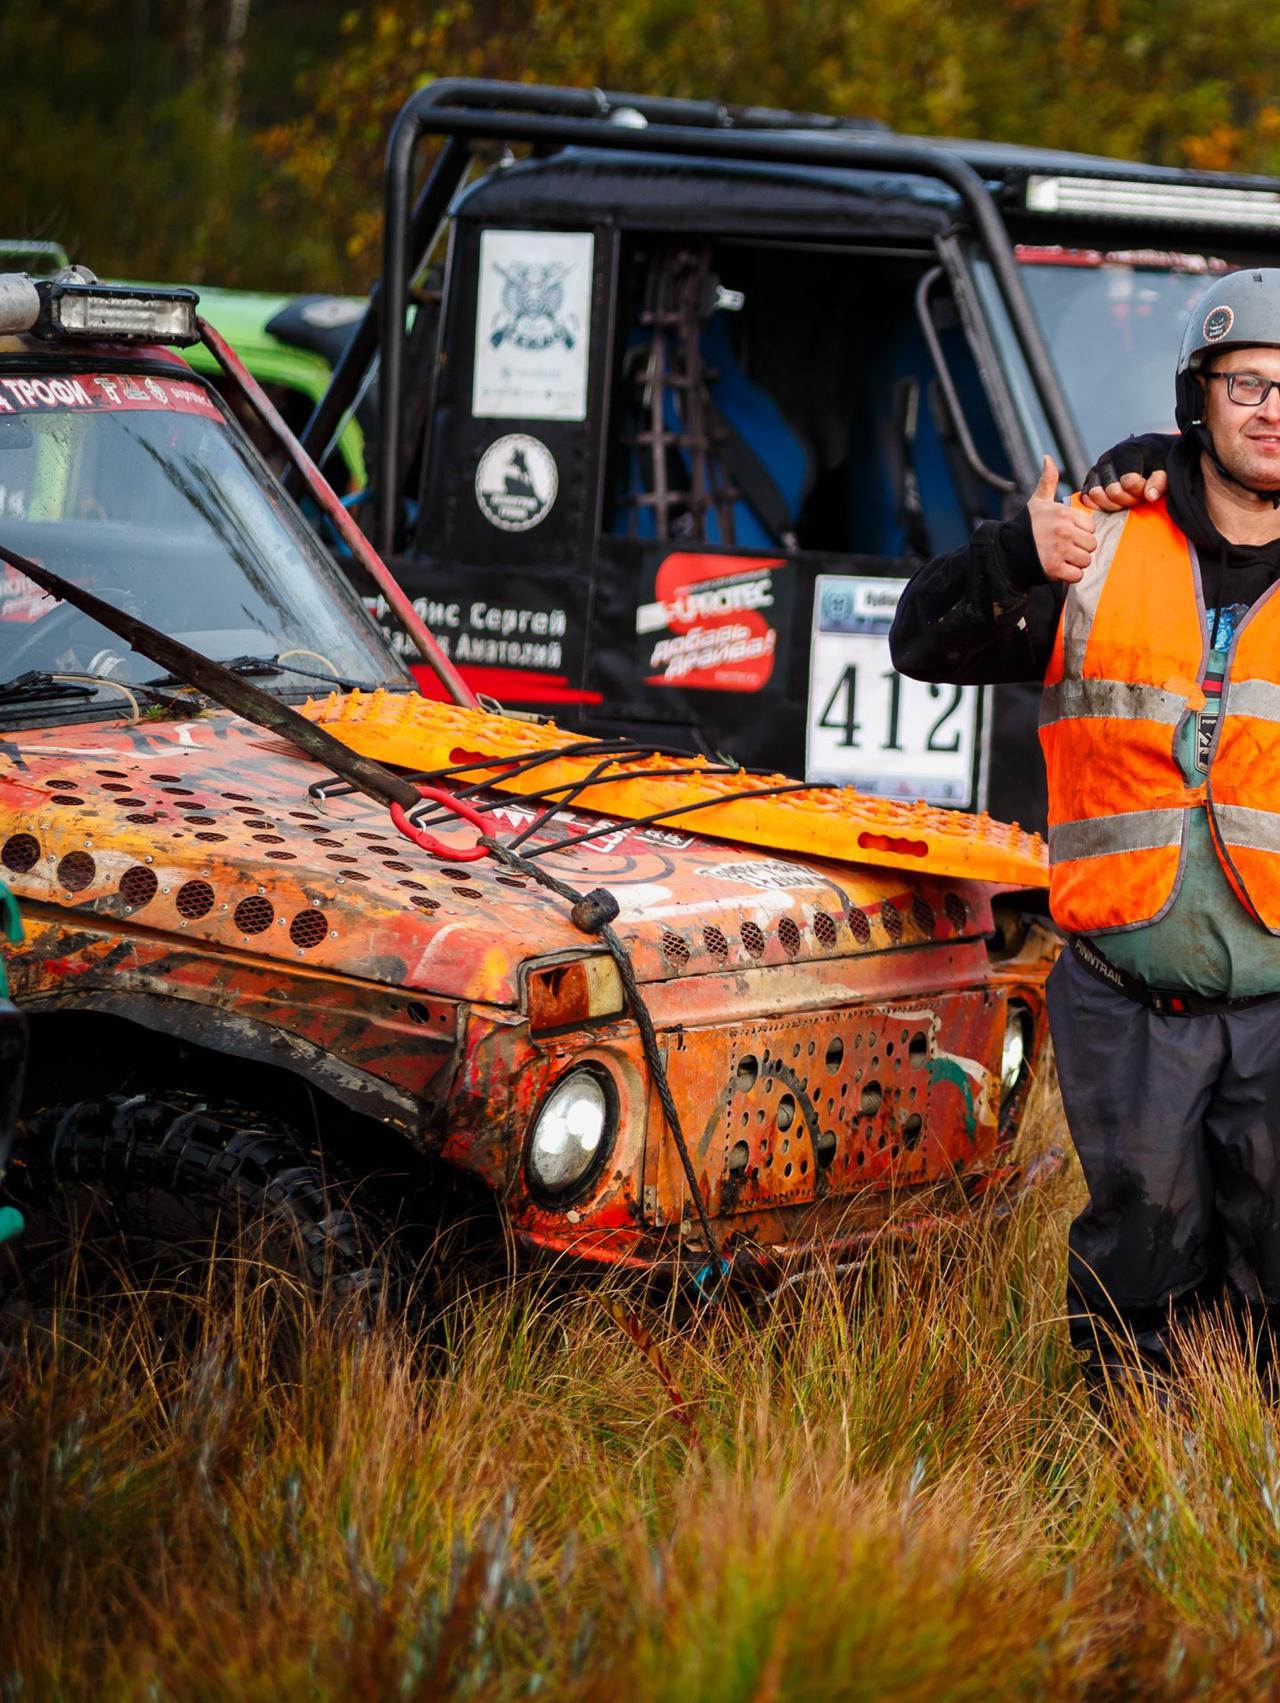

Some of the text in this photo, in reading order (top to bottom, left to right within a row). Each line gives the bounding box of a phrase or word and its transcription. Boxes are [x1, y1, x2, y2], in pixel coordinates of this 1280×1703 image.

[2, 379, 92, 407] ТРОФИ
[469, 602, 567, 637] Сергей
[454, 632, 563, 669] Анатолий
[819, 664, 964, 752] 412
[1074, 939, 1124, 987] FINNTRAIL
